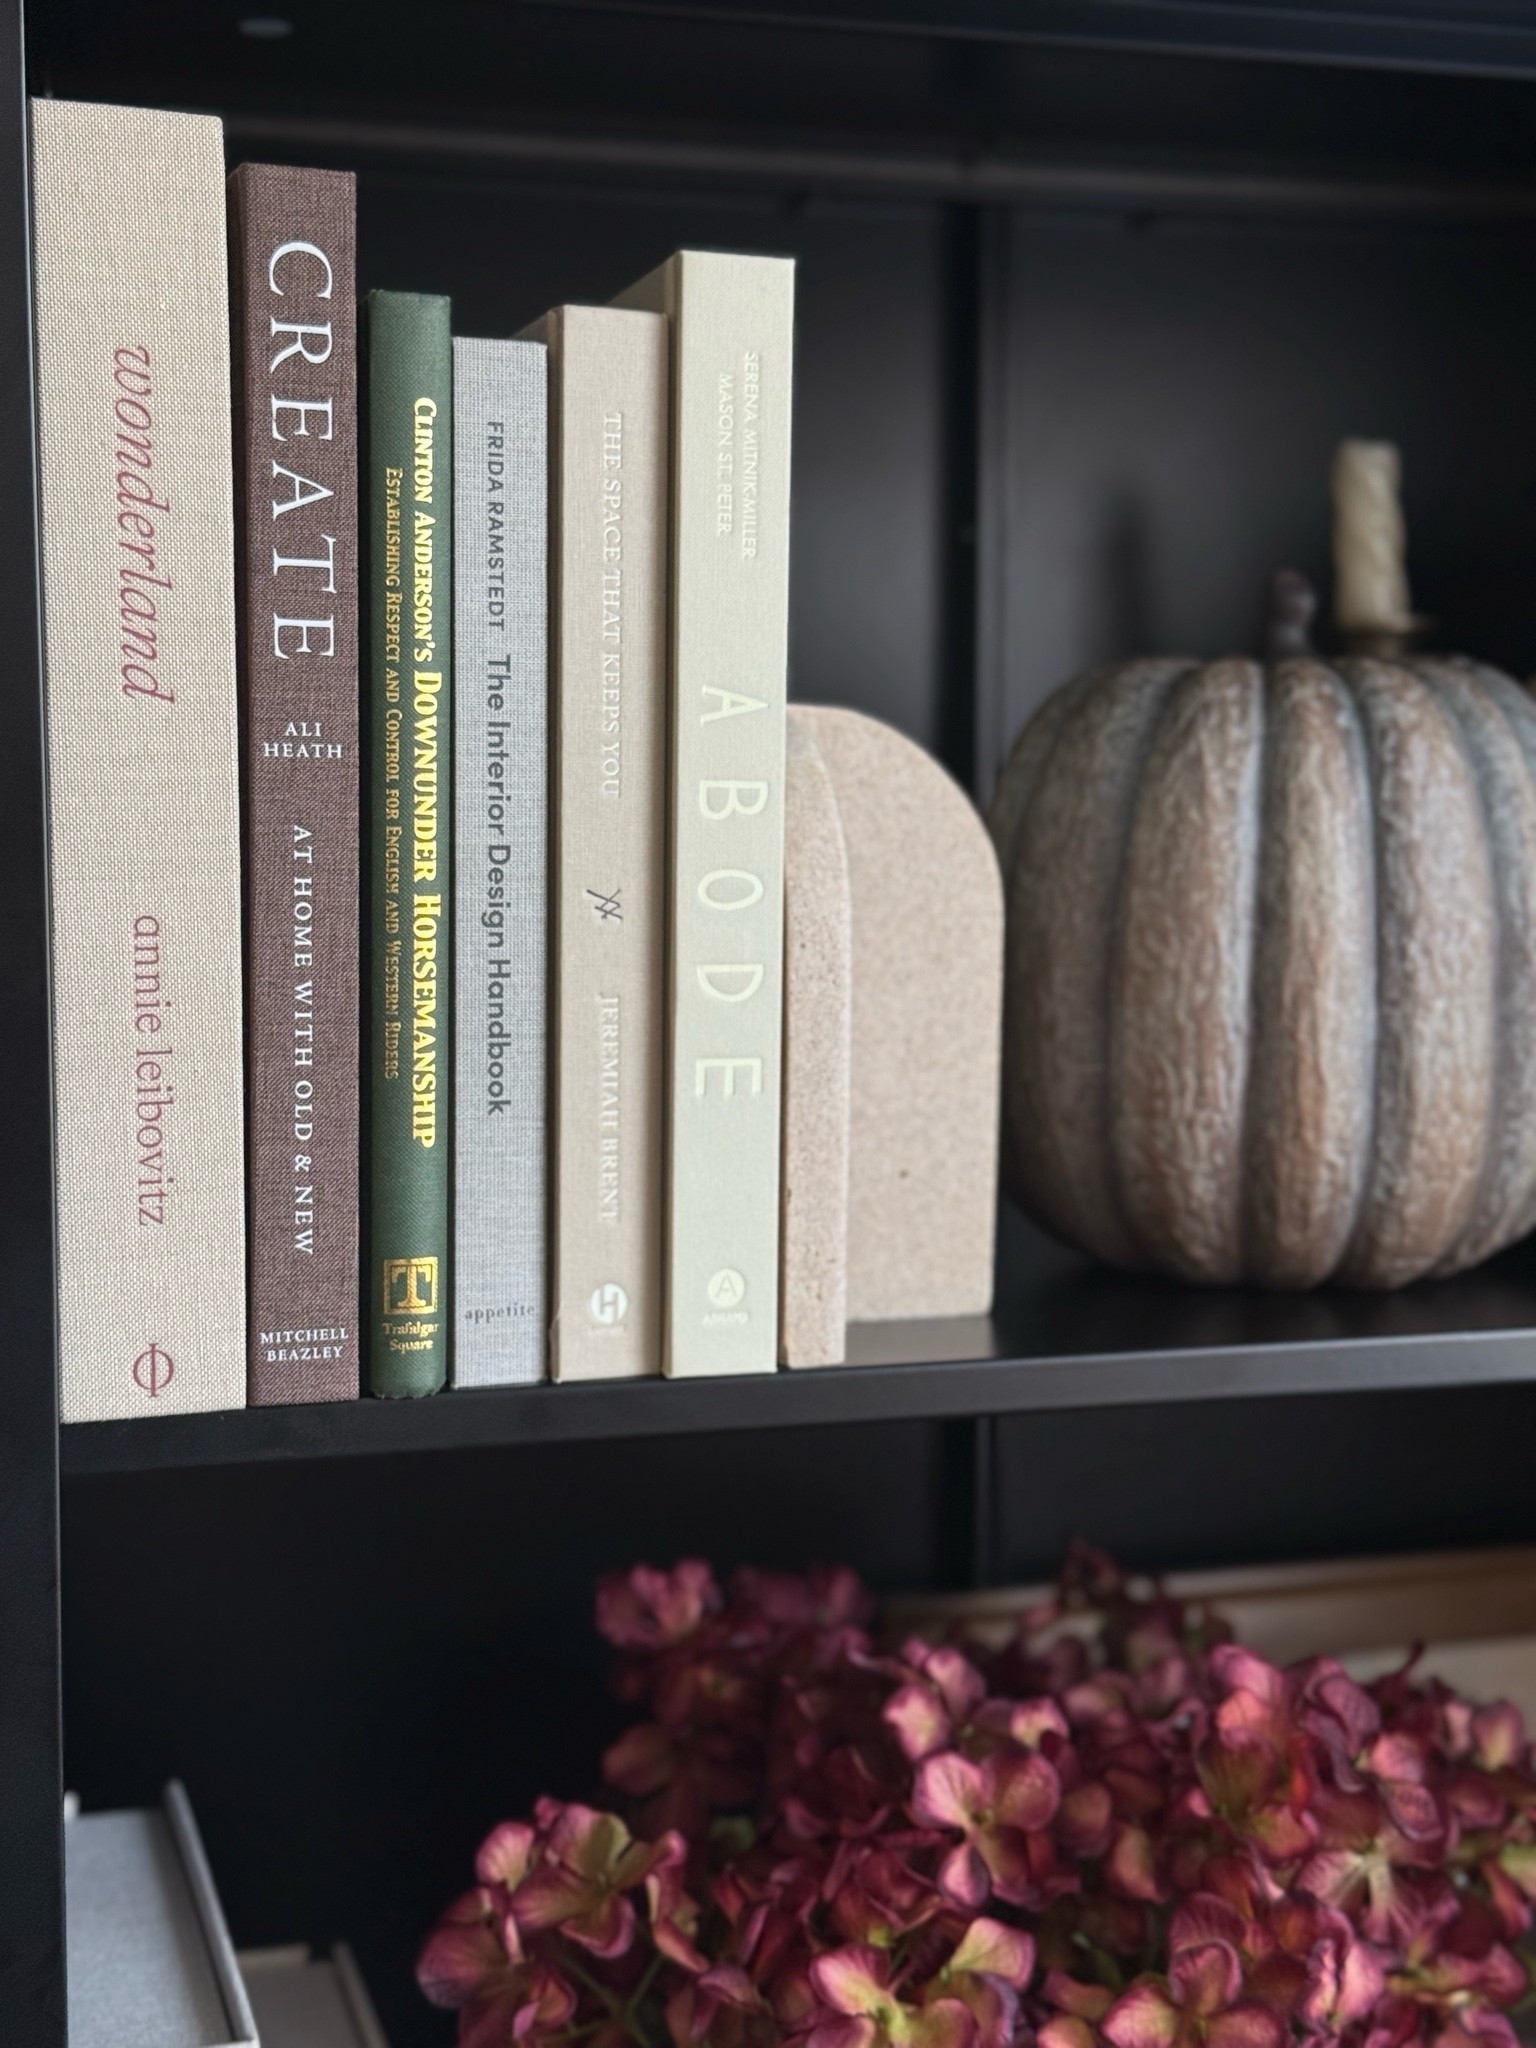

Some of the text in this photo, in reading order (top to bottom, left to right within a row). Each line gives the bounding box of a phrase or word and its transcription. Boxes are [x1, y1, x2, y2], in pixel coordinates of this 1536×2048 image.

[268, 239, 335, 661] CREATE
[717, 373, 734, 447] MASON
[717, 484, 733, 535] PETER
[741, 352, 759, 559] SERENA MITNIK-MILLER
[113, 346, 175, 703] wonderland
[486, 421, 505, 632] FRIDA RAMSTEDT
[602, 413, 623, 798] THE SPACE THAT KEEPS YOU
[263, 741, 343, 758] HEATH
[285, 722, 323, 738] ALI
[384, 467, 404, 1080] ESTABLISHING RESPECT AND CONTROL FOR ENGLISH AND WESTERN RIDERS
[412, 397, 443, 1148] CLINTON ANDERSON'S DOWNUNDER HORSEMANSHIP
[481, 654, 512, 1116] The Interior Design Handbook
[696, 686, 770, 1097] ABODE
[134, 915, 176, 1228] annie leibovitz
[293, 824, 315, 1256] AT HOME WITH OLD & NEW
[599, 995, 620, 1222] JEREMIAH BRENT
[260, 1327, 349, 1345] MITCHELL
[266, 1346, 344, 1362] BEAZLEY
[383, 1321, 439, 1338] Trafalgar
[389, 1339, 433, 1354] Square
[465, 1301, 535, 1324] appetite
